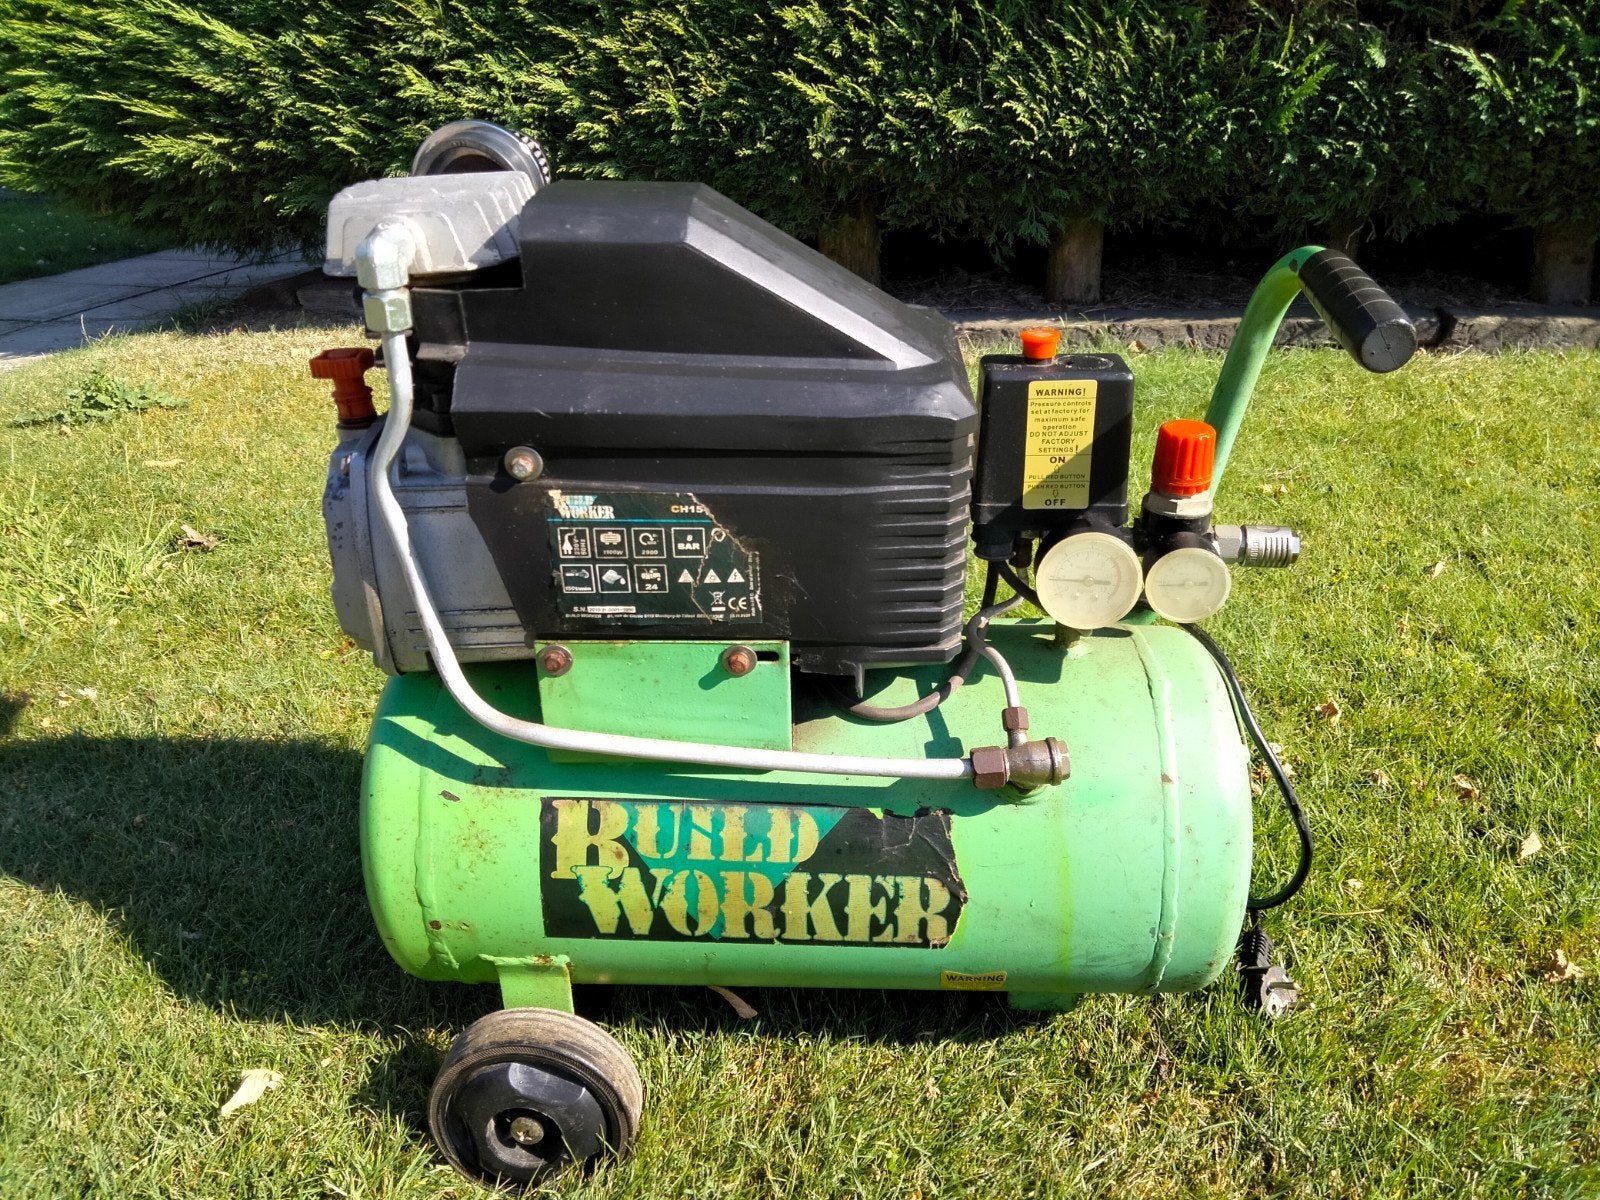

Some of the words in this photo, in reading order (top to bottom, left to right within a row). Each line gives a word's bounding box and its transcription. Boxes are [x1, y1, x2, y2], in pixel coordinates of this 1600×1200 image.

[1036, 388, 1086, 396] WARNING!
[557, 505, 615, 519] WORKER
[550, 800, 819, 879] BUILD
[573, 865, 950, 944] WORKER
